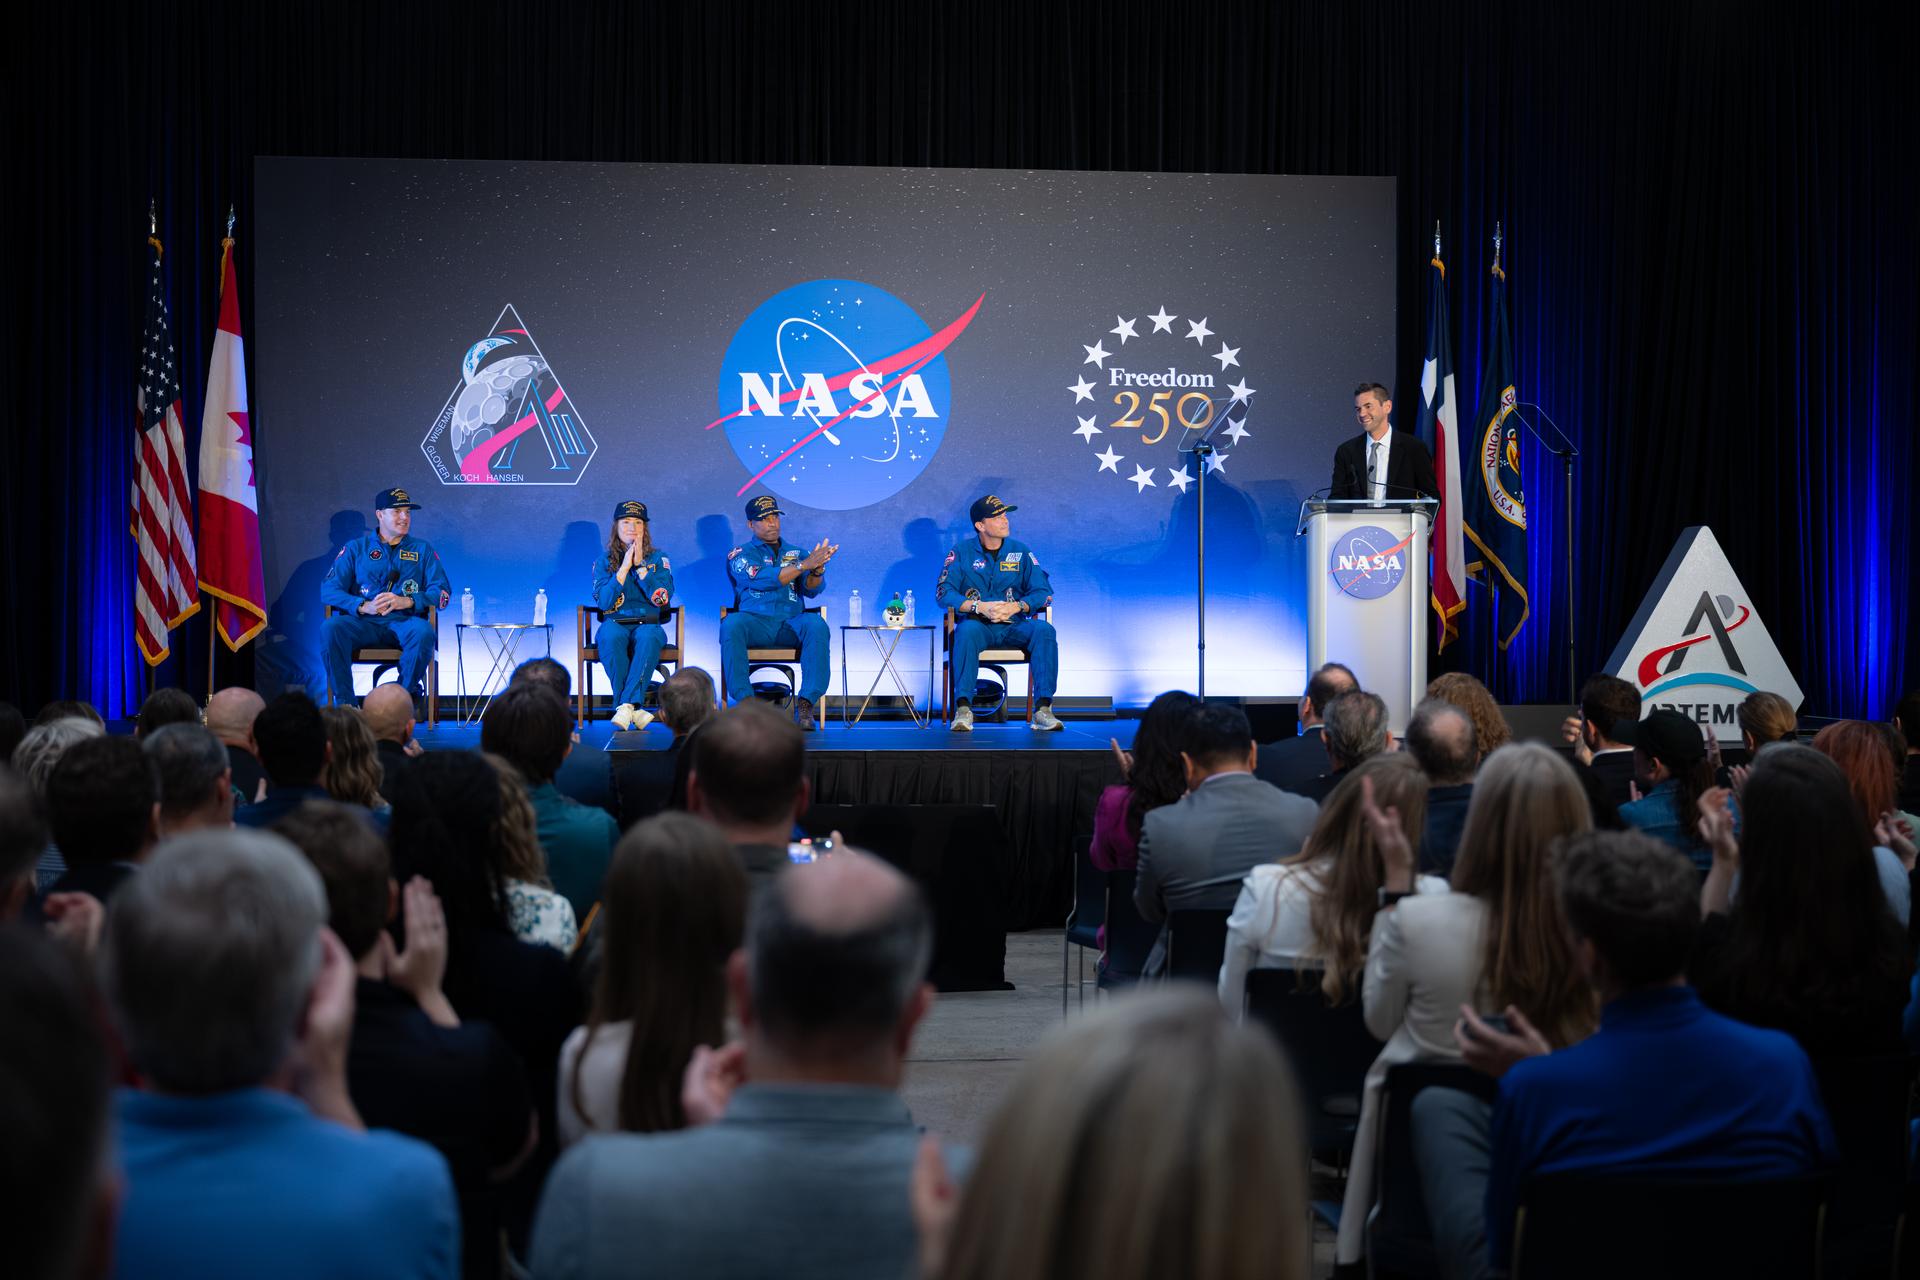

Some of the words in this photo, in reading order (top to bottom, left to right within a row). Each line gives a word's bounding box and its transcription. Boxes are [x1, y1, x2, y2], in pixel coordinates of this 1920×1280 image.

[1109, 368, 1215, 388] Freedom
[738, 372, 939, 419] NASA
[429, 405, 456, 444] WISEMAN
[1109, 390, 1214, 445] 250
[427, 446, 450, 479] GLOVER
[454, 474, 479, 482] KOCH
[486, 474, 524, 482] HANSEN
[1492, 490, 1514, 516] U.S.A.
[1338, 555, 1402, 570] NASA
